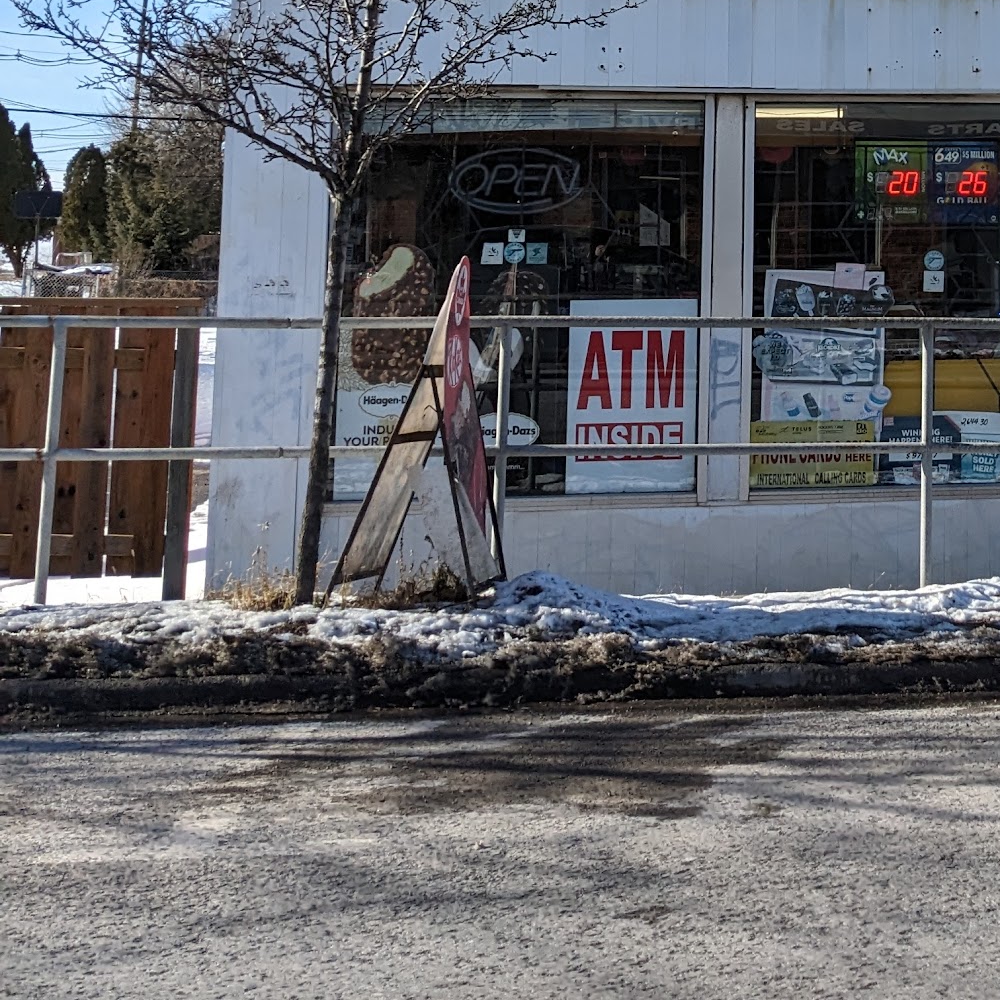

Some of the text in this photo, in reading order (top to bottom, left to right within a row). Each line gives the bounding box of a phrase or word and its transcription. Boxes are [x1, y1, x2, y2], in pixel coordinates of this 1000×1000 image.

[970, 151, 995, 159] MILLION
[456, 163, 581, 196] OPEN
[888, 171, 919, 195] 20
[958, 171, 987, 195] 26
[577, 330, 685, 409] ATM
[363, 395, 407, 407] Häagen-D
[363, 425, 394, 435] INDU
[343, 437, 379, 446] YOUR
[577, 425, 682, 460] INSIDE
[846, 453, 872, 462] HERE
[972, 457, 995, 465] SOLD
[972, 464, 995, 473] HERE
[757, 471, 866, 485] INTERNATIONAL CALLING CARDS
